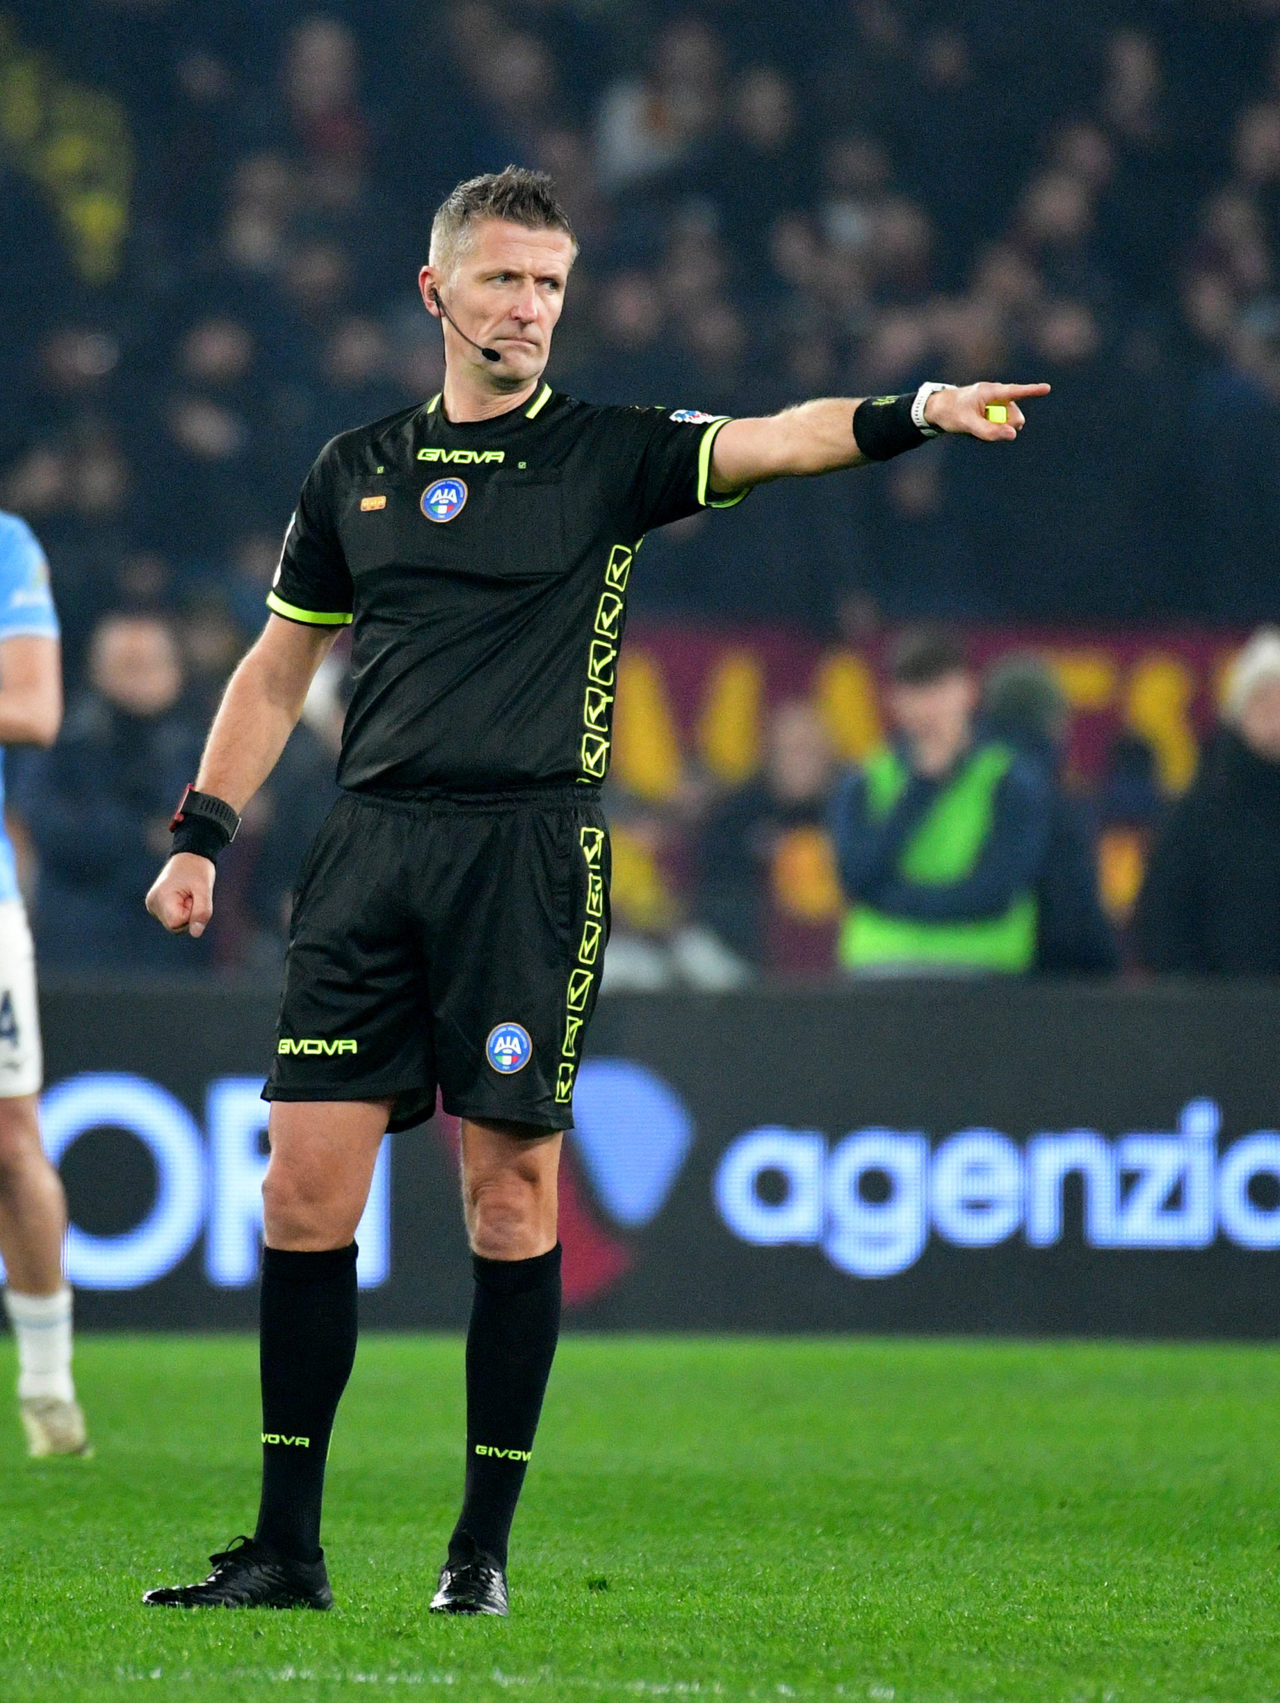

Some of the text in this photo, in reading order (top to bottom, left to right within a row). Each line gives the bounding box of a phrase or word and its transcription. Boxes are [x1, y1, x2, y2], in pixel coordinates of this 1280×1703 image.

[416, 448, 505, 464] GIVOVA
[429, 488, 458, 504] AIA
[493, 1035, 522, 1055] AIA
